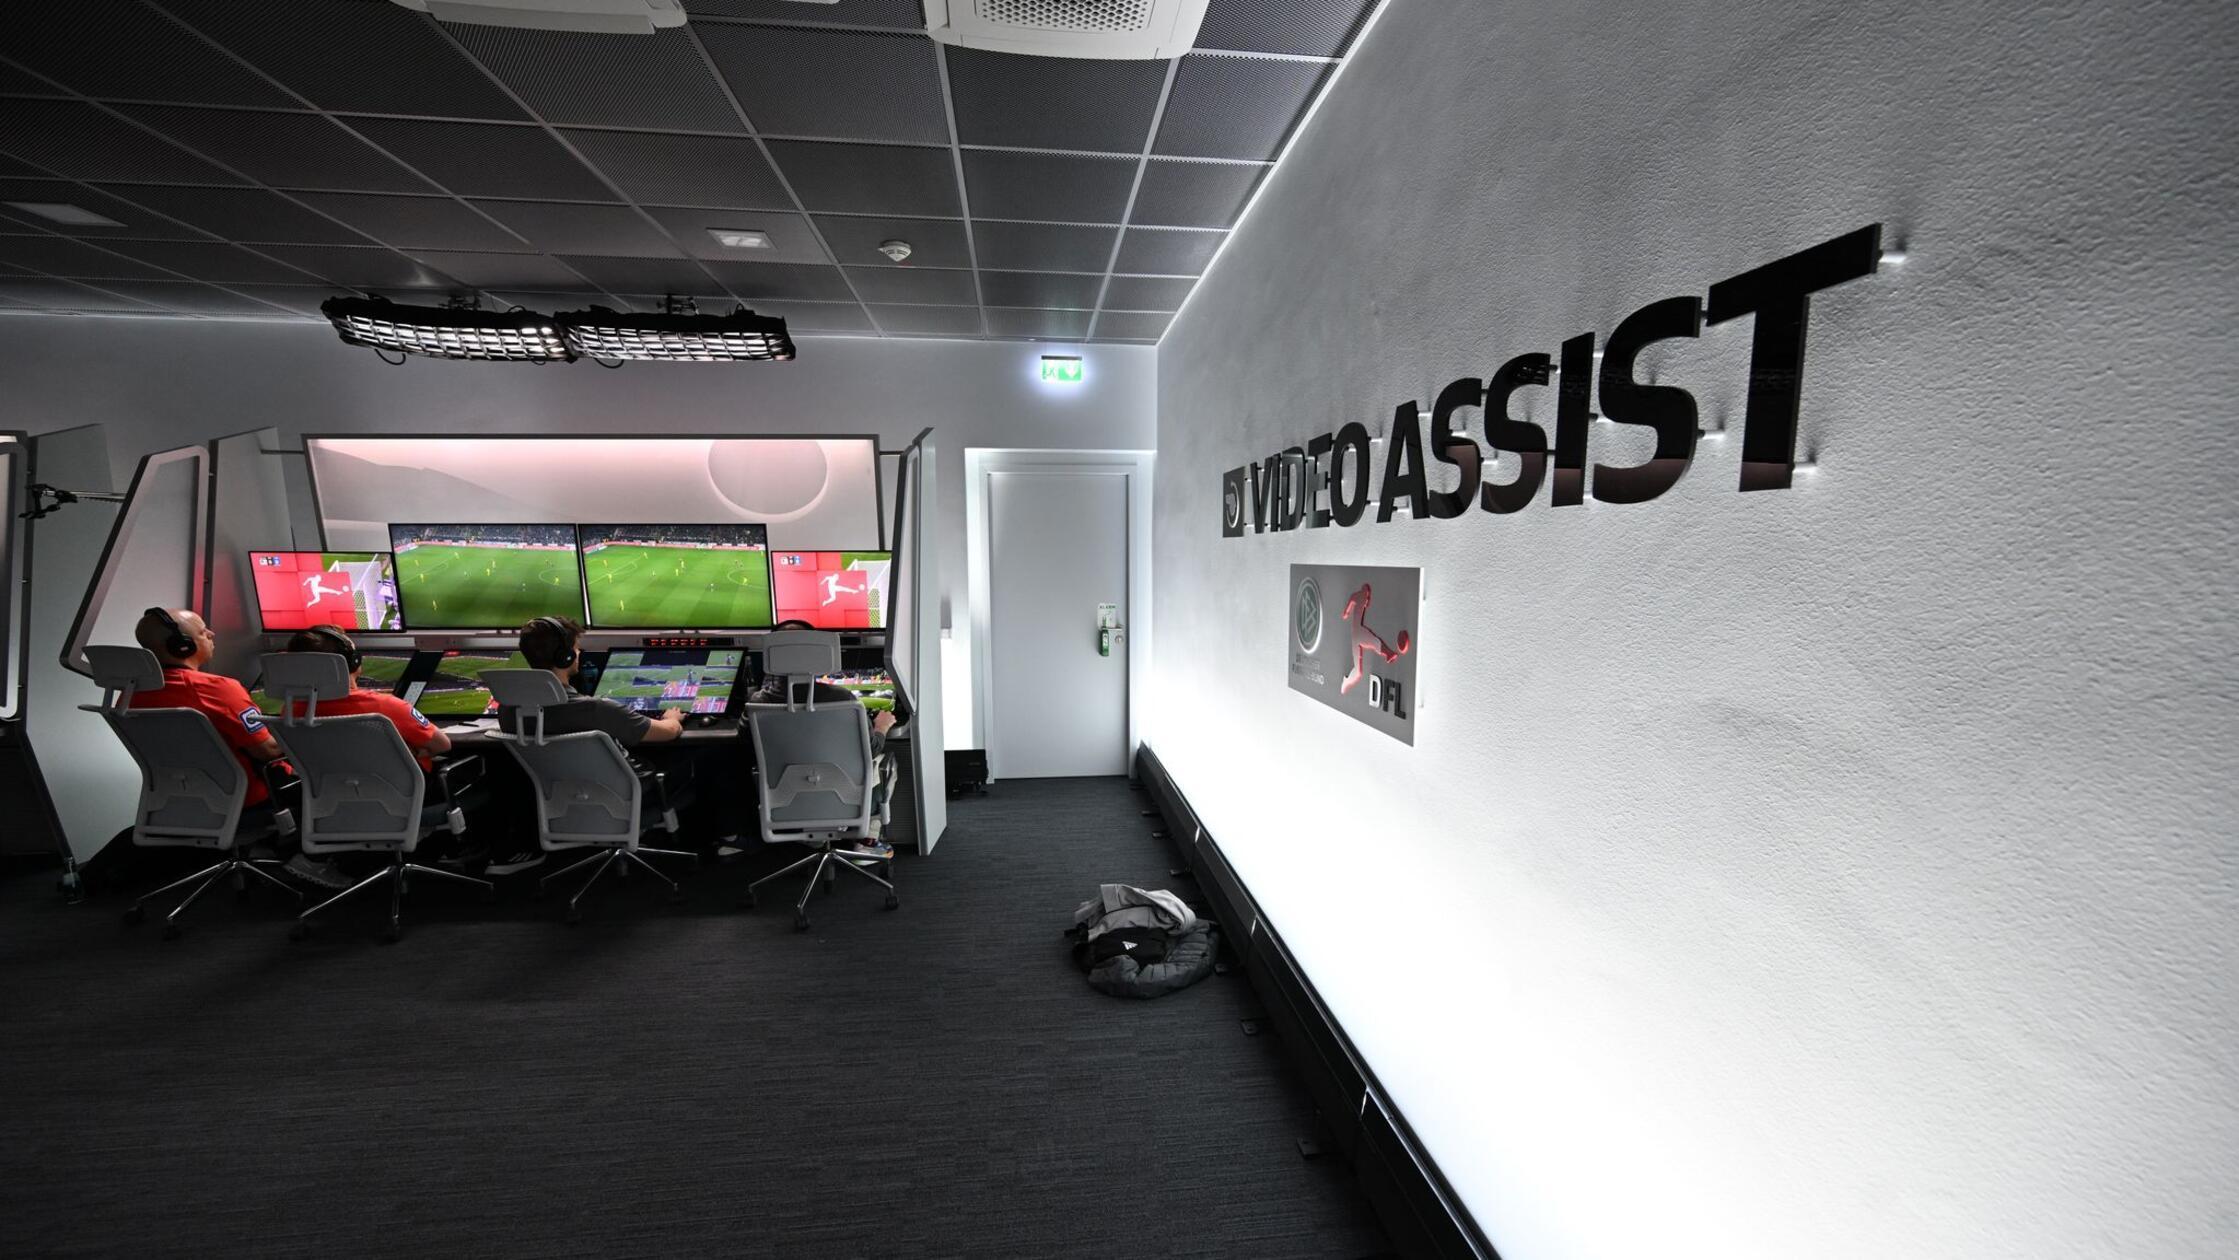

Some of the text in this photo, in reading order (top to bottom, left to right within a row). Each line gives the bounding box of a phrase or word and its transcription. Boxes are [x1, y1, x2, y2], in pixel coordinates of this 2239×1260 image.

[1250, 222, 1882, 534] VIDEO ASSIST
[1369, 673, 1406, 720] DFL
